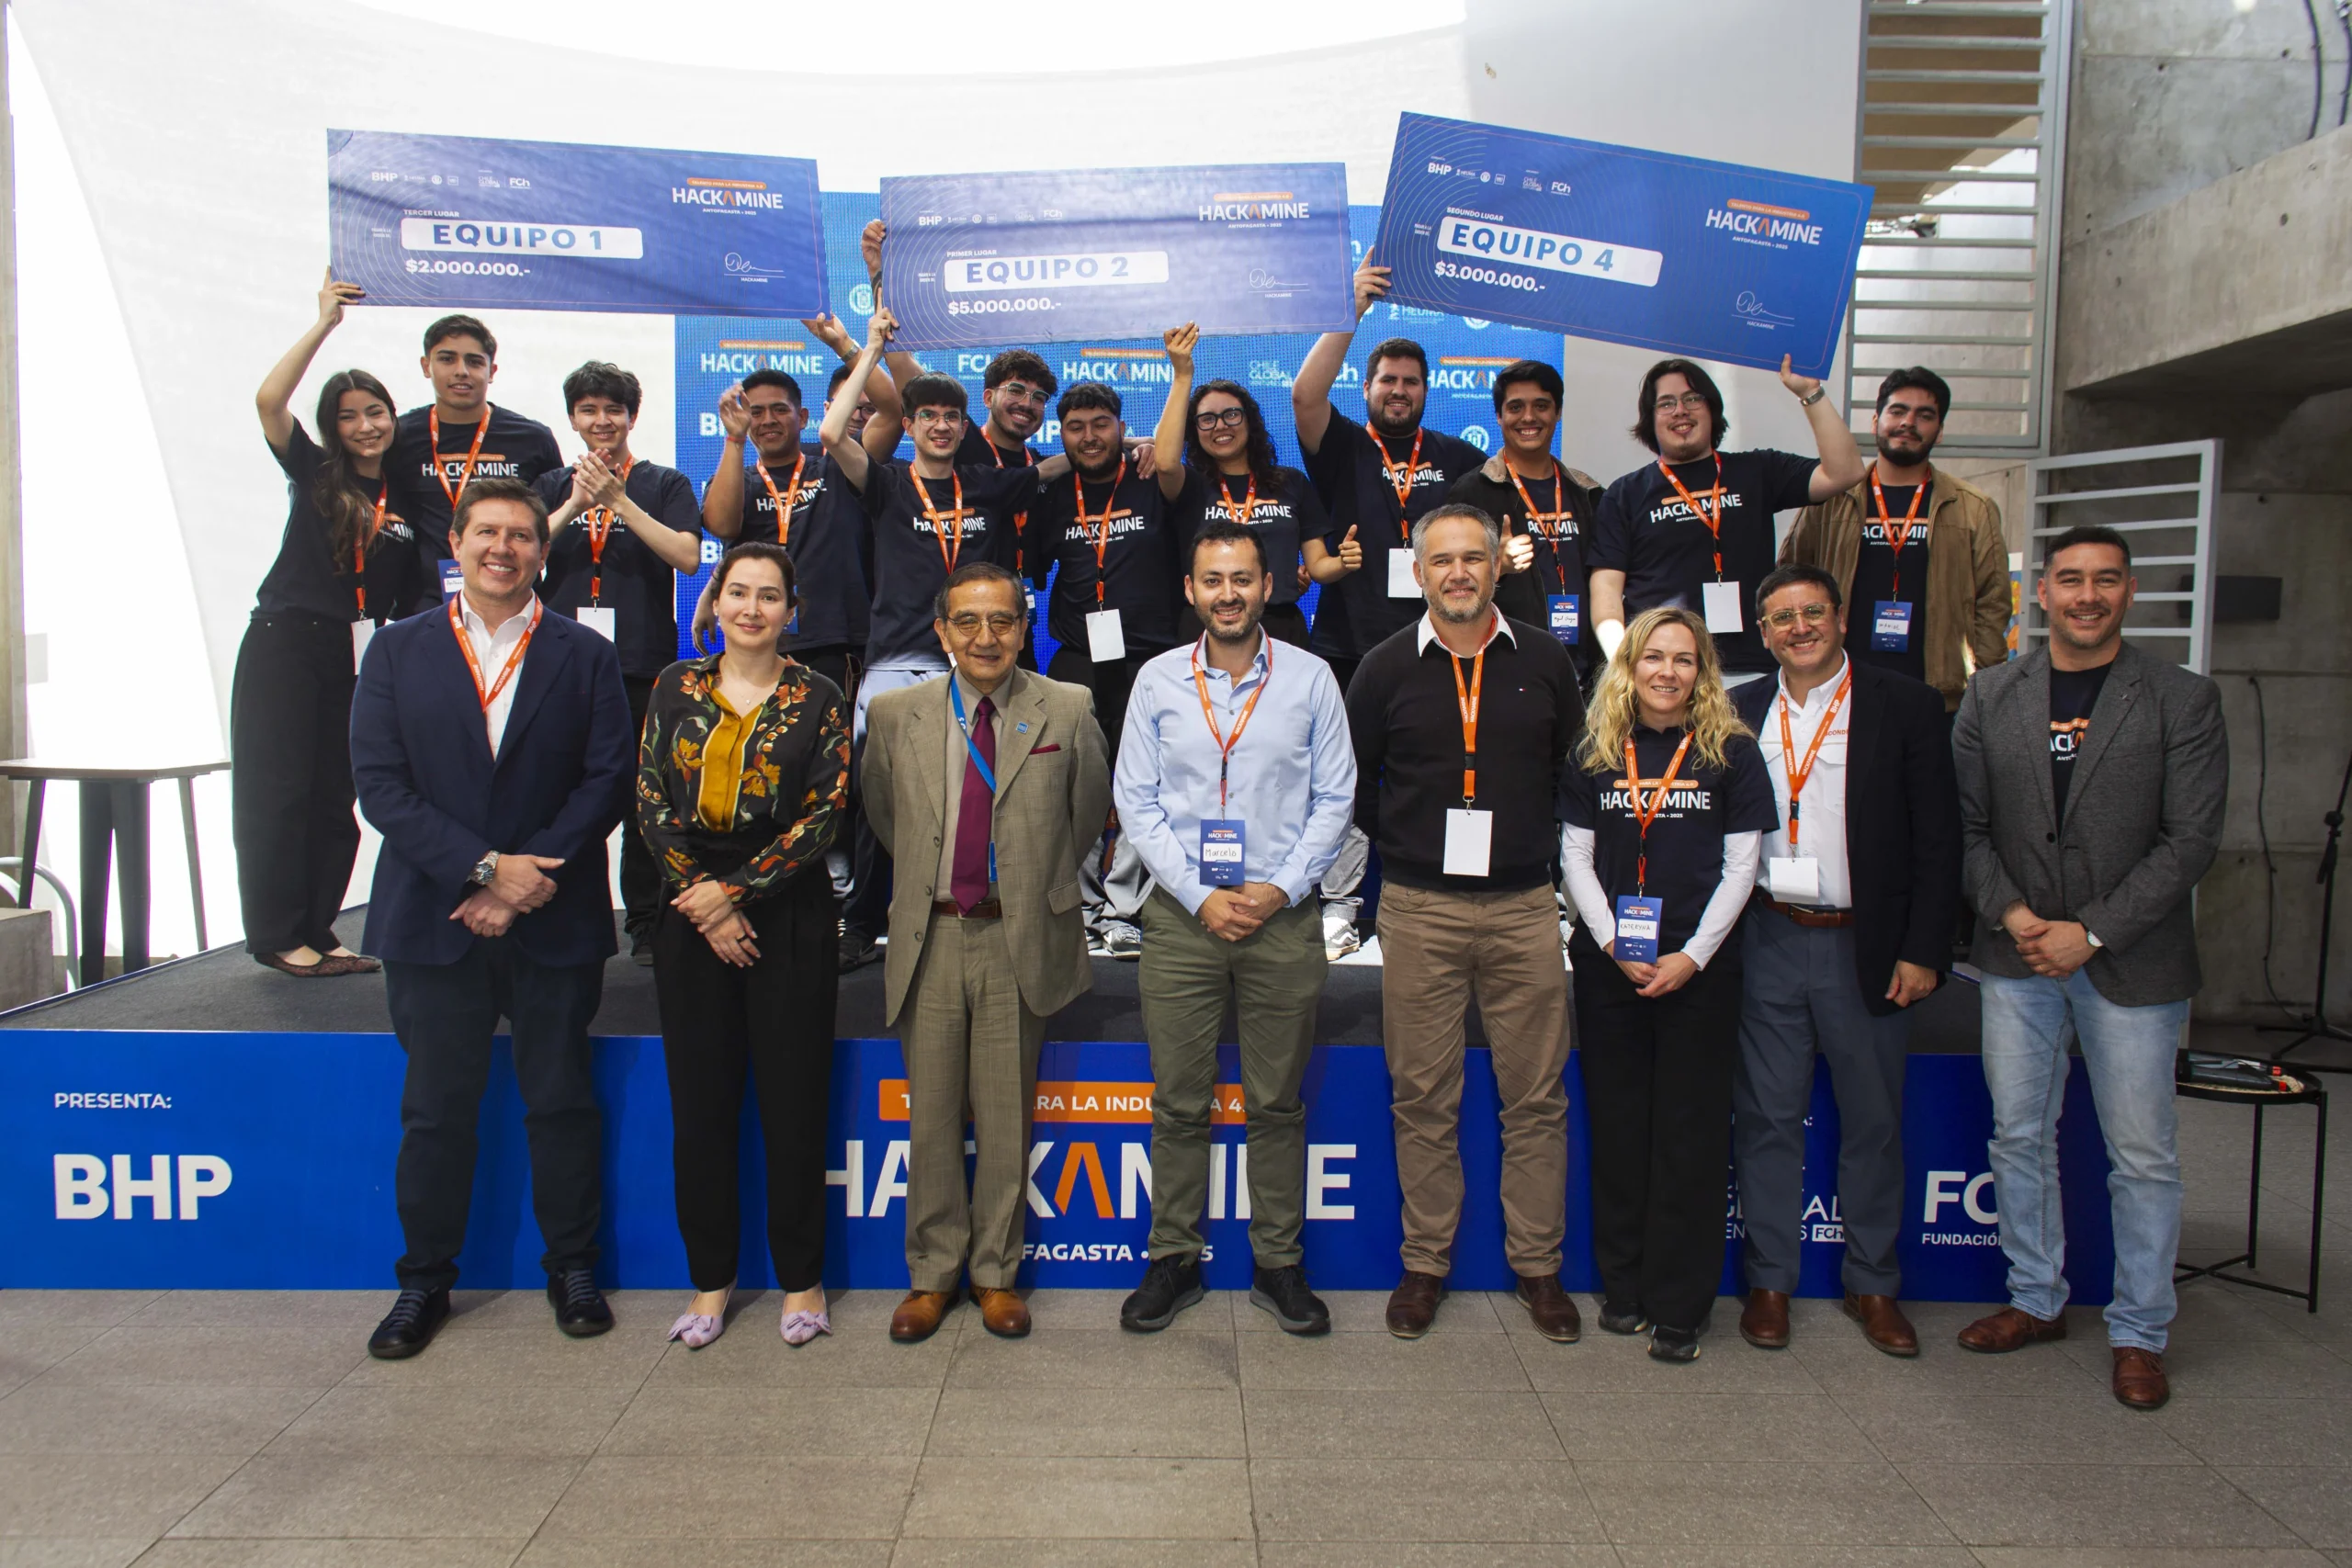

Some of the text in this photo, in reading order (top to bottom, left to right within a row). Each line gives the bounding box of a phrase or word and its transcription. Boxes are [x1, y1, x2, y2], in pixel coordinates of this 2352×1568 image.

[371, 172, 398, 183] BHP
[1428, 163, 1452, 175] BHP
[509, 177, 531, 187] FCh
[1551, 181, 1571, 194] FCh
[672, 186, 784, 209] HACKAMINE
[403, 209, 433, 217] TERCER
[1043, 209, 1063, 218] FCh
[1198, 202, 1310, 221] HACKAMINE
[1446, 207, 1504, 222] SEGUNDO LUGAR
[919, 216, 943, 226] BHP
[1705, 209, 1823, 245] HACKAMINE
[433, 223, 602, 251] EQUIPO 1
[946, 249, 997, 258] PRIMER LUGAR
[1451, 223, 1614, 272] EQUIPO 4
[405, 258, 531, 276] $2.000.000.-
[967, 256, 1129, 285] EQUIPO 2
[1434, 260, 1545, 292] $3.000.000.-
[947, 298, 1062, 316] $5.000.000.-
[1747, 321, 1775, 330] HACKAMINE
[700, 353, 823, 375] HACKAMINE
[1062, 361, 1175, 382] HACKAMIN
[1829, 699, 1840, 714] BHP
[1802, 749, 1816, 776] HACKAMINE
[54, 1091, 173, 1110] PRESENTA:
[1072, 1096, 1100, 1111] LA
[53, 1153, 233, 1221] BHP
[1922, 1232, 2001, 1247] FUNDACIÓ
[1021, 1244, 1134, 1262] FAGASTA
